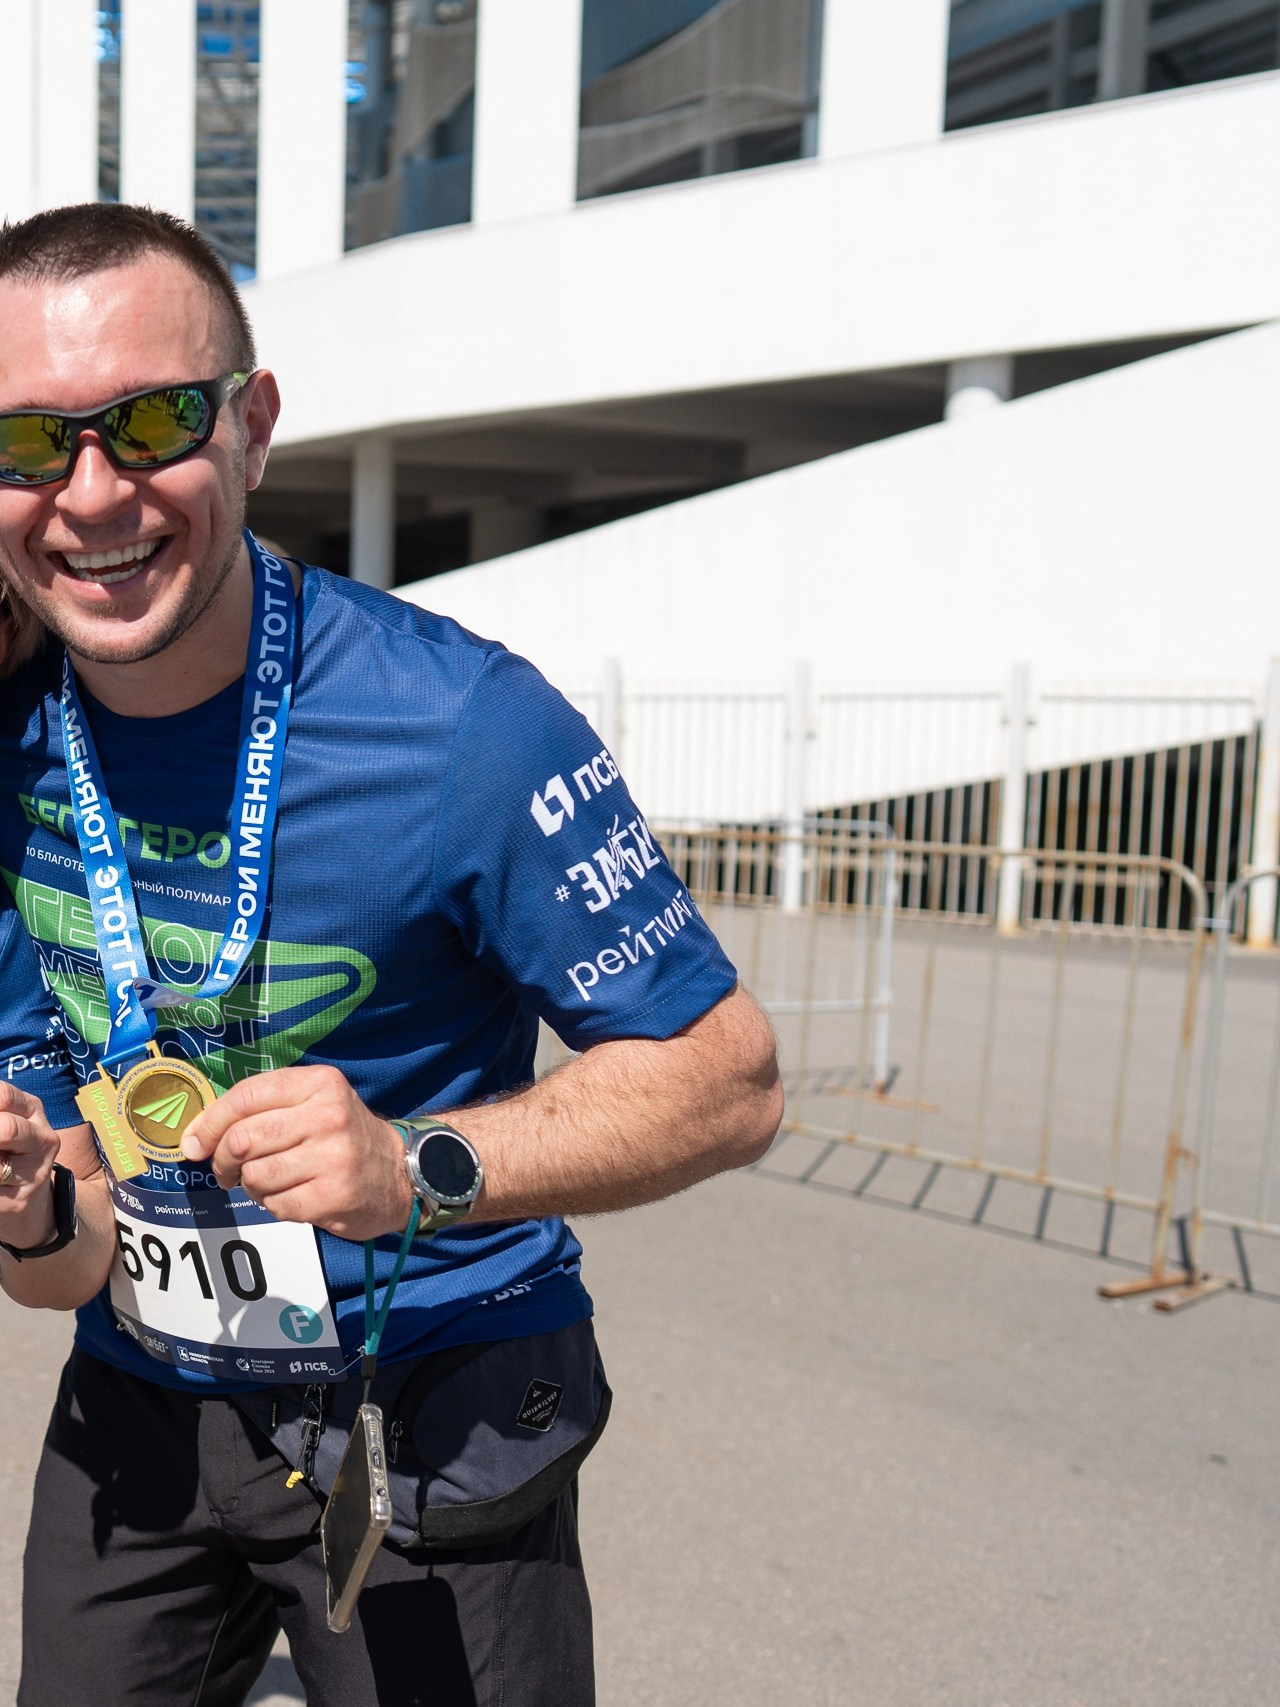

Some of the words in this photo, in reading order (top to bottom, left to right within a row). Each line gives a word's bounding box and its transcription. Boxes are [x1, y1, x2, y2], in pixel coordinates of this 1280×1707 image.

[257, 590, 287, 683] ЭТОТ
[239, 691, 280, 859] МЕНЯЮТ
[572, 749, 619, 801] ПСБ
[26, 846, 36, 856] 10
[65, 707, 114, 861] МЕНЯЮТ
[94, 865, 133, 953] ЭТОТ
[213, 868, 259, 980] ГЕРОИ
[120, 1226, 268, 1301] 5910
[289, 1311, 310, 1338] F
[304, 1362, 329, 1371] ПСБ
